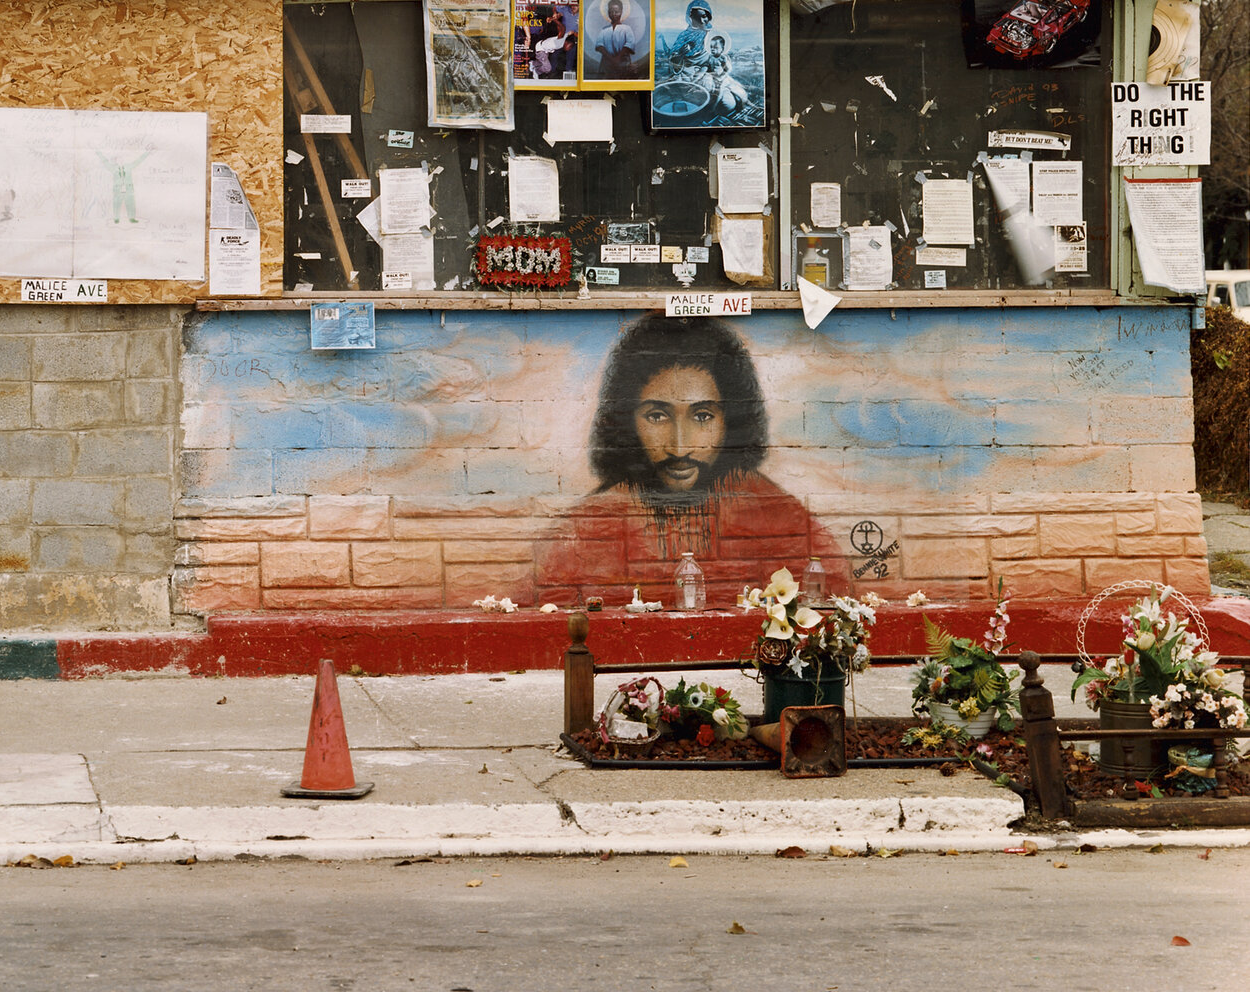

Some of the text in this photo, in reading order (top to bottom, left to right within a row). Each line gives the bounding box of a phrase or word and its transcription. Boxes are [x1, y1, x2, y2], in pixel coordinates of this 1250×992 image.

[1114, 83, 1205, 103] DO THE
[1131, 108, 1189, 128] RIGHT
[486, 245, 562, 275] MOM
[24, 280, 107, 298] MALICE AVE.
[28, 290, 64, 302] GREEN
[670, 294, 752, 314] MALICE AVE.
[674, 305, 711, 315] GREEN
[873, 563, 890, 579] 92
